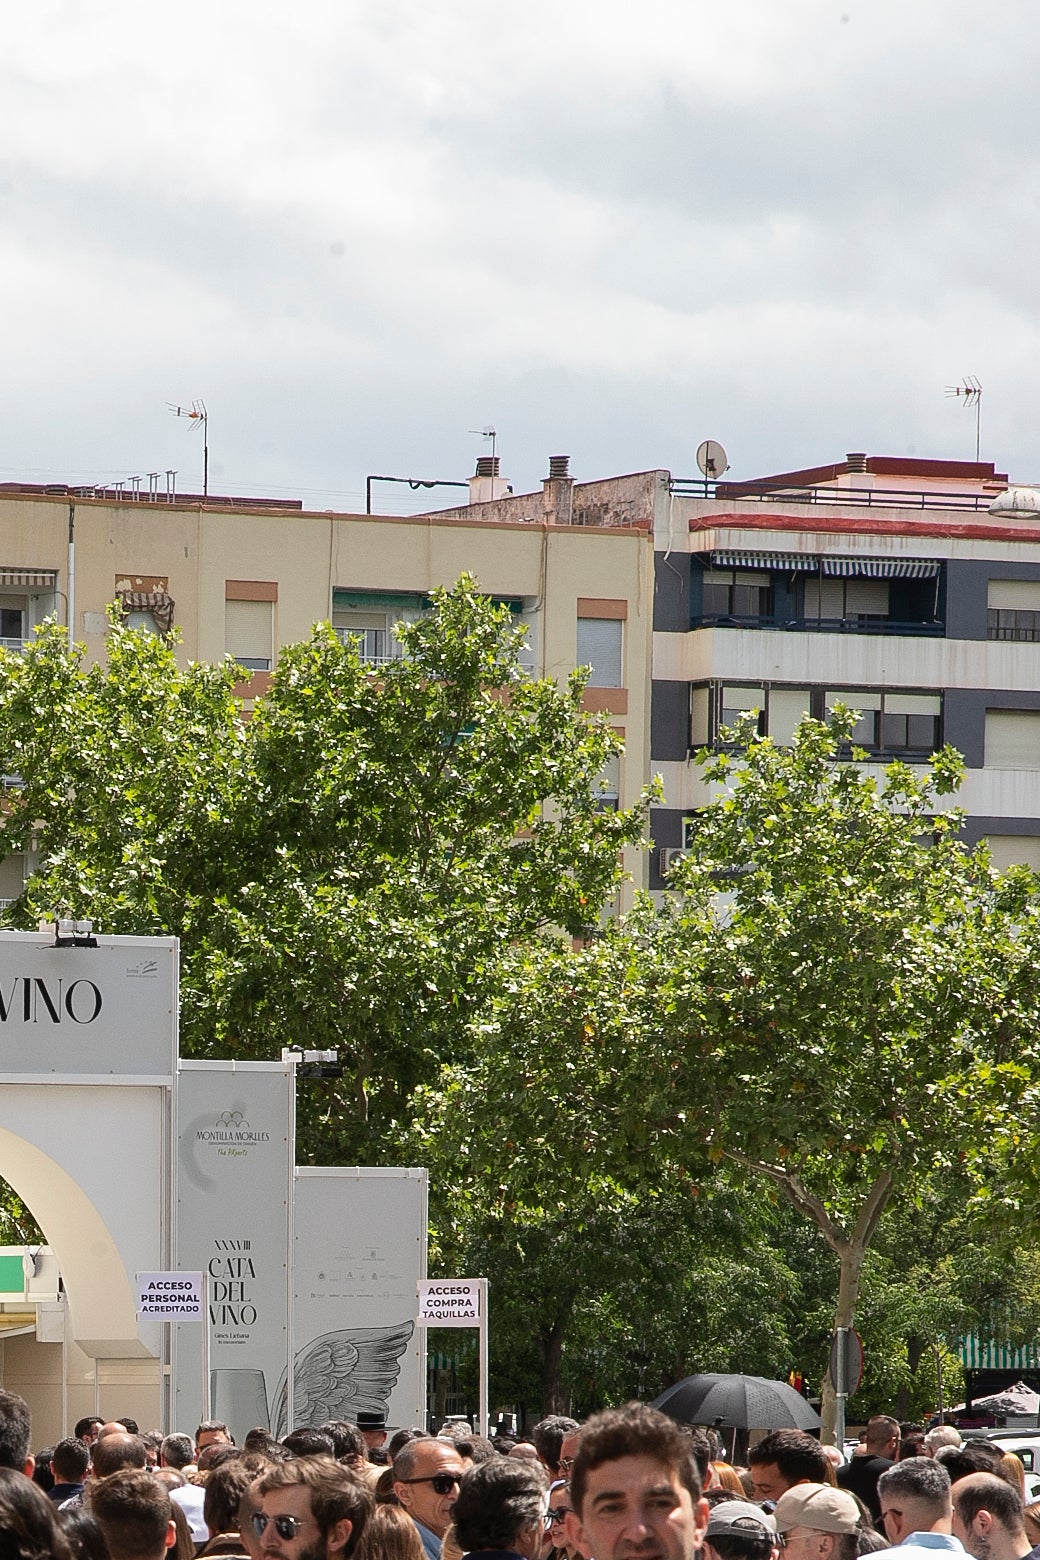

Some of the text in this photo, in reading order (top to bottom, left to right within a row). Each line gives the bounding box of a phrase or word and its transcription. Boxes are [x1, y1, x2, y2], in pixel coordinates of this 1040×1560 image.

[195, 1131, 234, 1141] MONTILLA
[214, 1240, 251, 1251] XXXVIII
[208, 1257, 256, 1278] CATA
[148, 1281, 193, 1290] ACCESO
[427, 1286, 471, 1295] ACCESO
[214, 1281, 252, 1302] DEL
[141, 1294, 200, 1303] PERSONAL
[426, 1298, 473, 1307] COMPRA
[209, 1304, 257, 1325] VINO
[423, 1310, 476, 1320] TAQUILLAS
